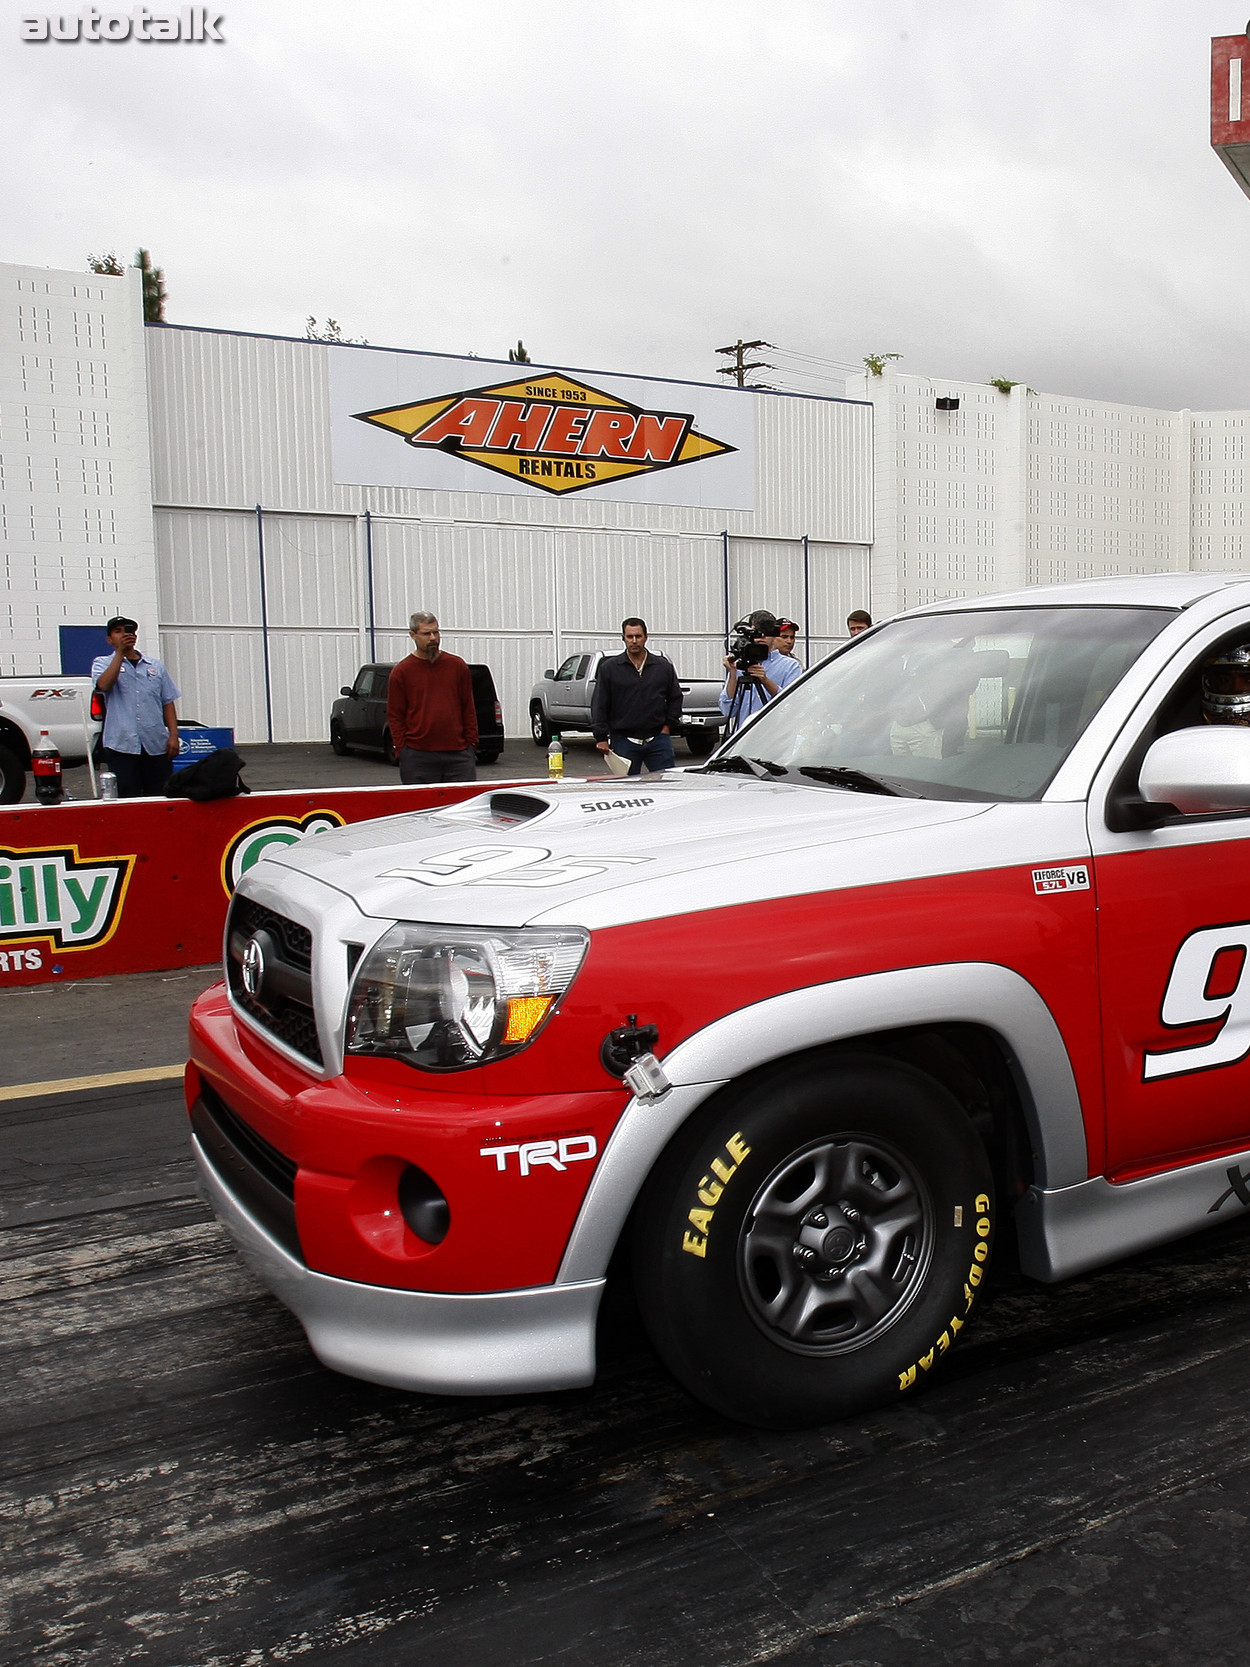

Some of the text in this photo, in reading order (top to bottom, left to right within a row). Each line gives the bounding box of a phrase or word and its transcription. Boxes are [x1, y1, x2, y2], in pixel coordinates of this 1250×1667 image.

[525, 386, 588, 401] SINCE 1953
[409, 396, 688, 463] AHERN
[518, 458, 597, 479] RENTALS
[30, 688, 79, 700] FX4
[580, 798, 654, 813] 504HP
[1066, 871, 1086, 885] V8
[480, 1134, 598, 1177] TRD
[682, 1131, 752, 1259] EAGLE
